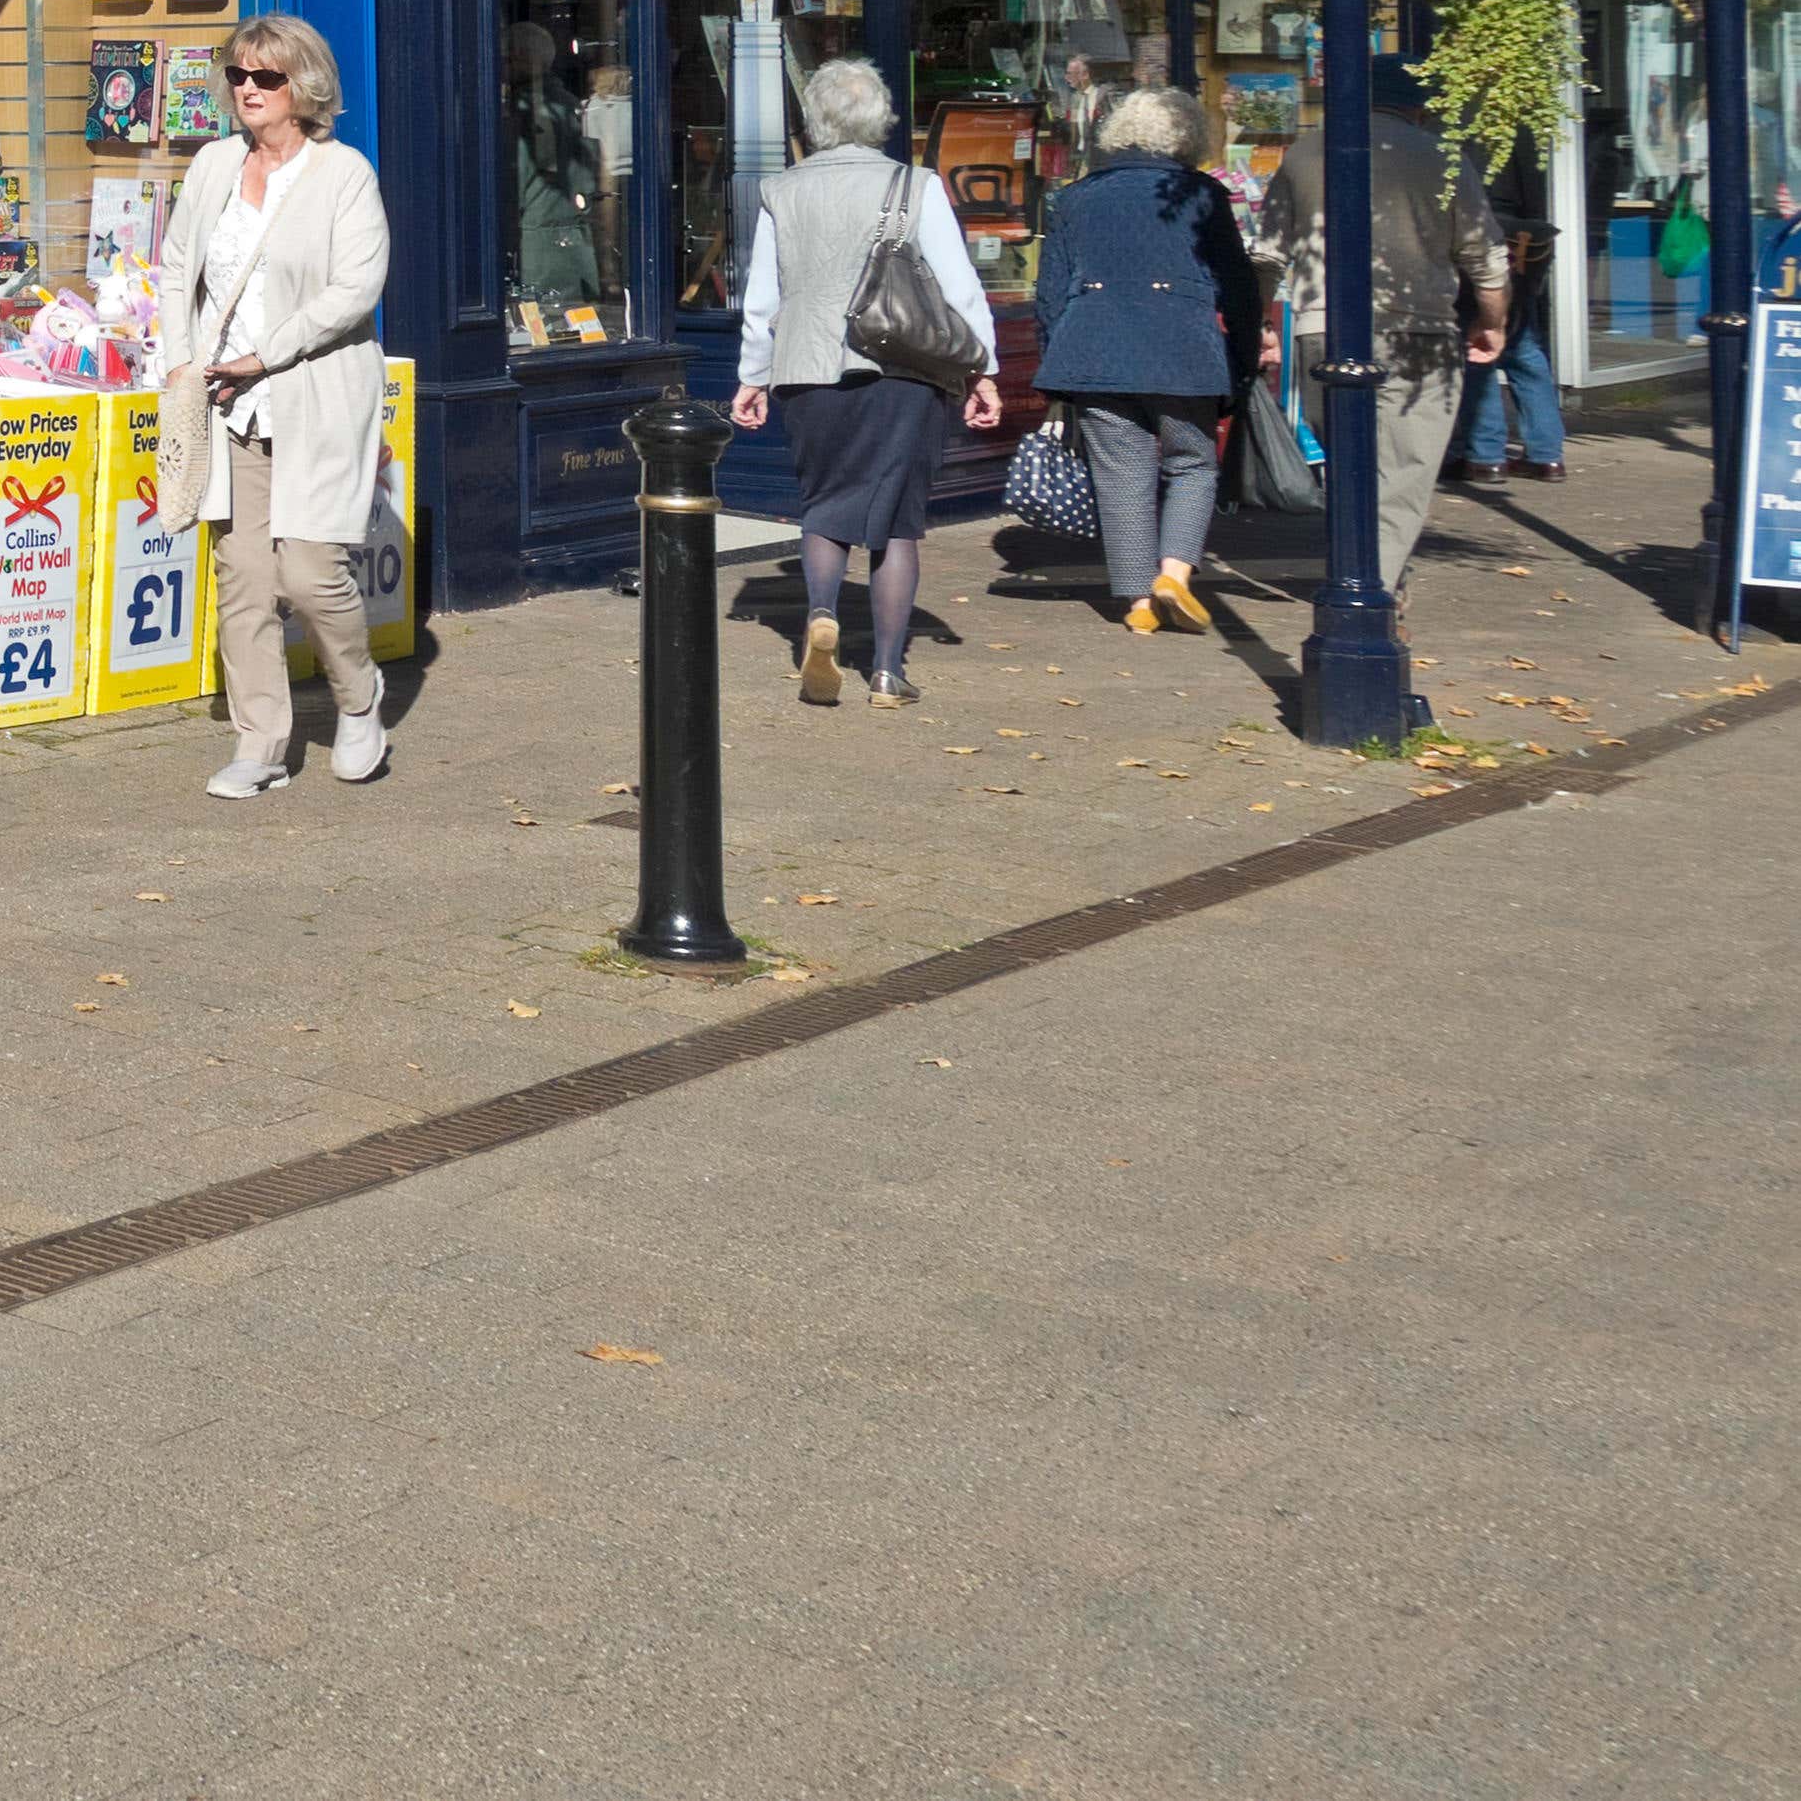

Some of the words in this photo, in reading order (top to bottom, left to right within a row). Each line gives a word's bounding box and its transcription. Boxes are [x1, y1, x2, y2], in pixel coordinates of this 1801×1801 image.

[560, 448, 591, 478] Fine
[595, 447, 626, 467] Pens
[5, 528, 57, 549] Collins
[142, 533, 174, 557] only
[37, 545, 72, 570] Wall
[11, 577, 47, 598] Map
[25, 607, 44, 623] Wall
[46, 605, 66, 624] Map
[127, 568, 185, 646] £1
